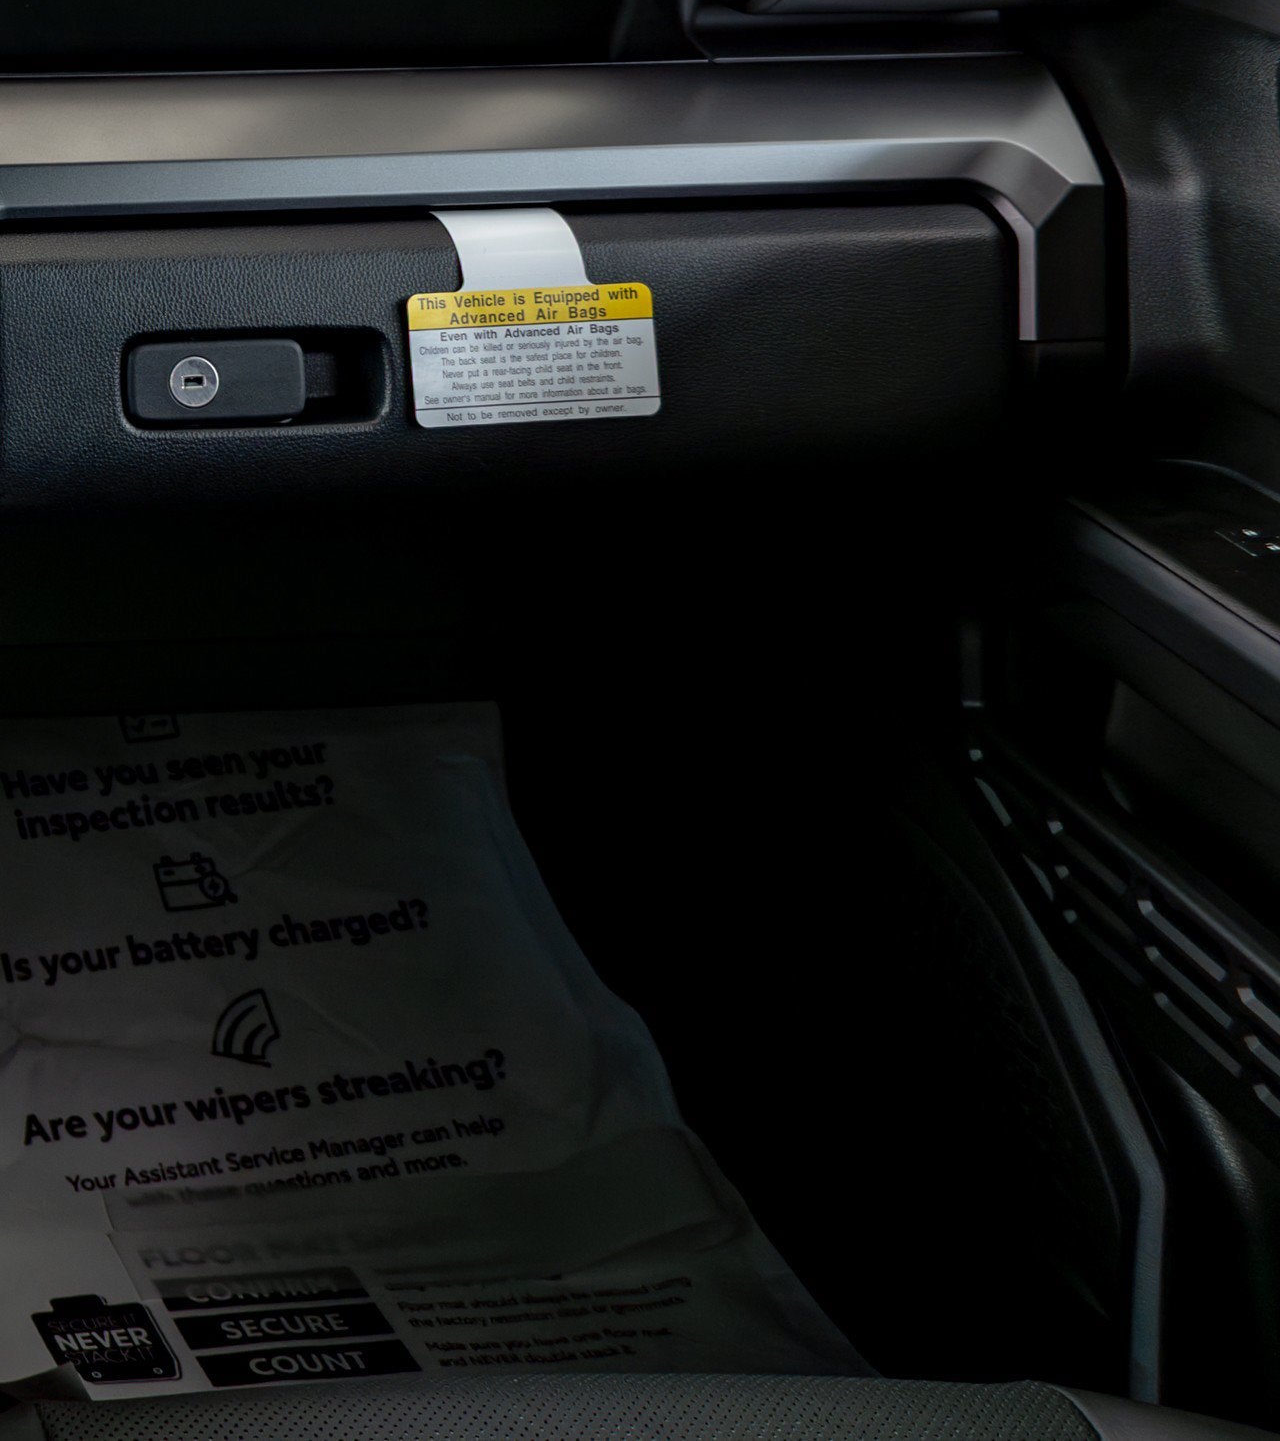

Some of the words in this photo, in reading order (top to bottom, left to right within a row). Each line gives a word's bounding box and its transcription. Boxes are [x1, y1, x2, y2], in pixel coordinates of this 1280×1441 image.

[417, 297, 446, 310] This
[455, 294, 505, 309] Vehicle
[513, 292, 526, 305] is
[534, 289, 600, 306] Equipped
[608, 287, 638, 300] with
[450, 309, 525, 325] Advanced
[536, 307, 558, 321] Air
[569, 306, 606, 322] Bags
[440, 331, 468, 342] Even
[474, 329, 497, 340] with
[505, 326, 560, 339] Advanced
[567, 324, 583, 335] Air
[590, 322, 620, 337] Bags
[446, 412, 462, 422] Not
[468, 412, 477, 421] to
[481, 410, 492, 421] be
[497, 408, 537, 419] removed
[543, 406, 574, 418] except
[578, 404, 590, 417] by
[595, 404, 627, 415] owner.
[0, 769, 89, 799] Have
[95, 762, 159, 797] you
[166, 751, 247, 781] seen
[249, 742, 326, 779] your
[14, 794, 200, 841] inspection
[204, 775, 335, 818] results?
[0, 952, 33, 984] Is
[38, 947, 120, 986] your
[125, 929, 259, 967] battery
[268, 898, 430, 950] charged?
[24, 1113, 88, 1145] Are
[94, 1099, 177, 1142] your
[185, 1080, 311, 1125] wipers
[317, 1048, 508, 1106] streaking?
[53, 1324, 152, 1353] NEVER
[221, 1310, 349, 1339] SECURE
[248, 1350, 368, 1378] COUNT
